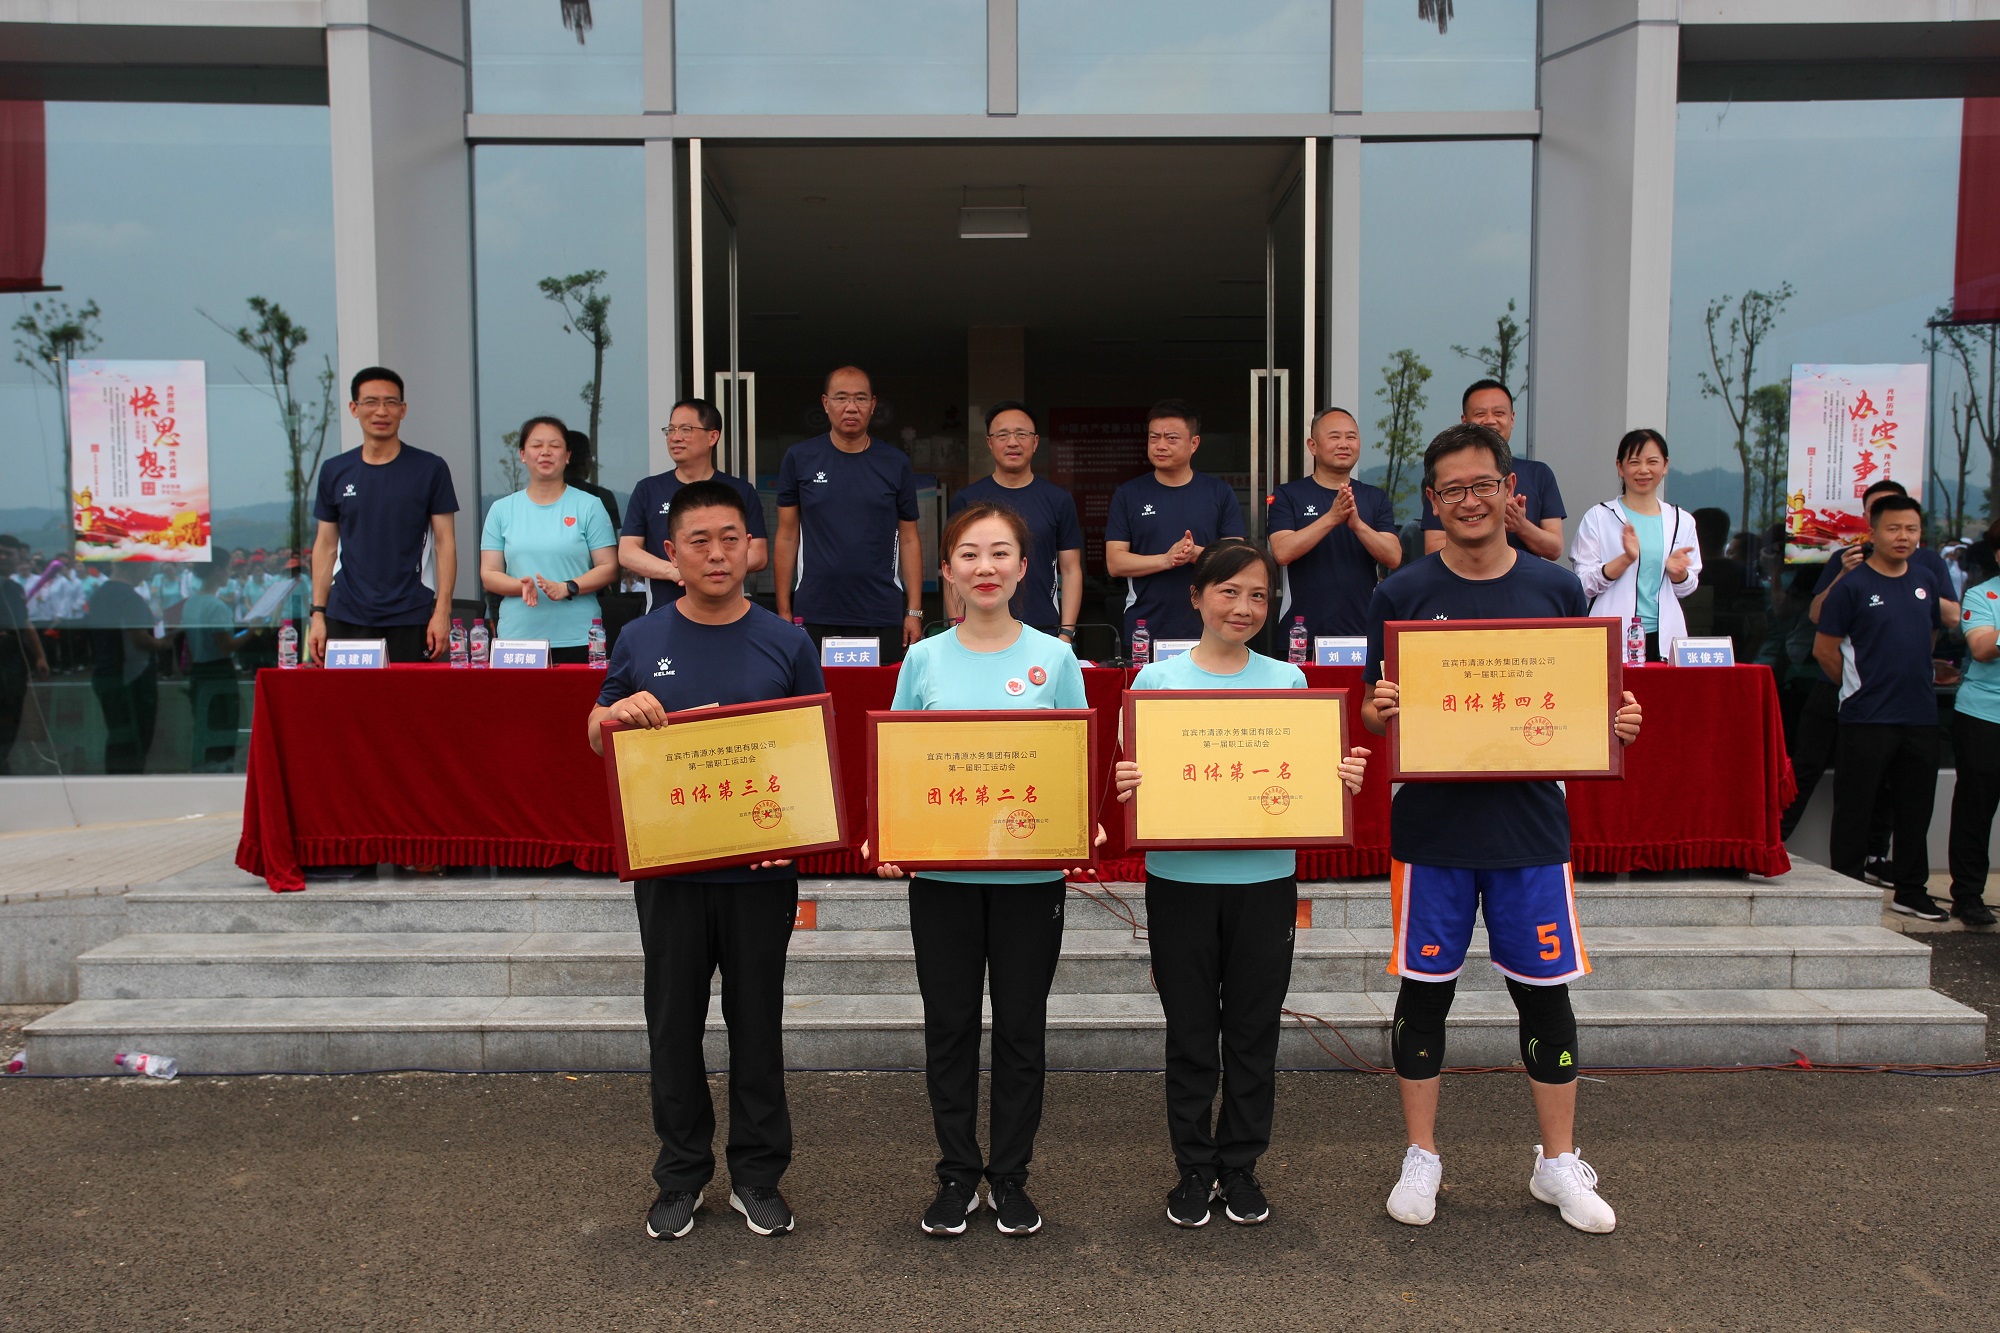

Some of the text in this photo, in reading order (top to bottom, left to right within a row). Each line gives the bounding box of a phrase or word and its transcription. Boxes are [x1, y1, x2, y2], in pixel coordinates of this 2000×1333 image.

[335, 653, 373, 665] 吴建刚
[503, 653, 536, 664] 邹莉娜
[834, 651, 871, 663] 任大庆
[1441, 657, 1556, 668] 宜宾市清源水务集团有限公司
[1686, 652, 1724, 664] 张俊芳
[653, 670, 676, 678] KELME
[1463, 669, 1534, 679] 第一届职工运动会
[1442, 691, 1556, 713] 团体第四名
[1181, 727, 1291, 737] 宜宾市清源水务集团有限公司
[1203, 739, 1270, 749] 第一届职工运动会
[666, 740, 777, 762] 宜宾市清源水务集团有限公司
[926, 750, 1037, 761] 宜宾市清源水务集团有限公司
[688, 754, 757, 771] 第一届职工运动会
[948, 762, 1016, 772] 第一届职工运动会
[1182, 760, 1292, 783] 团体第一名
[670, 774, 782, 806] 团体第三名
[927, 784, 1038, 807] 团体第二名
[1536, 922, 1561, 961] 5
